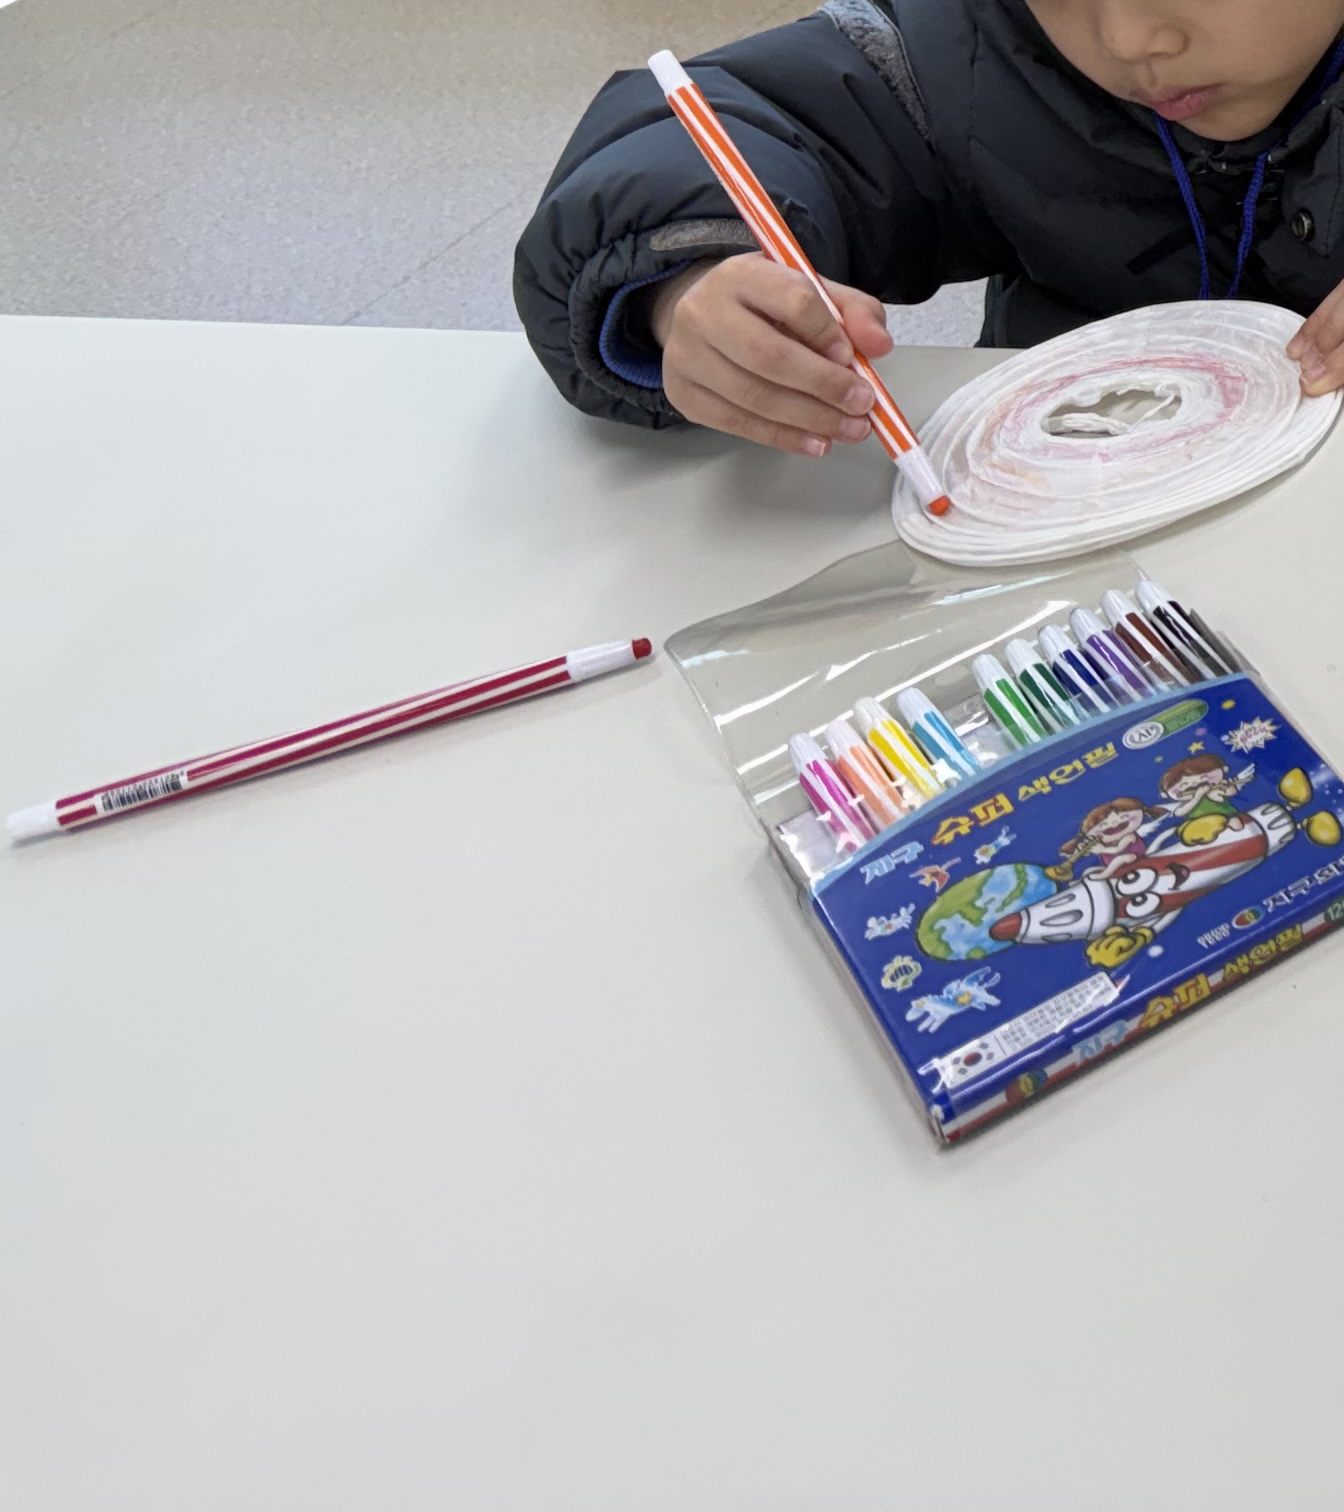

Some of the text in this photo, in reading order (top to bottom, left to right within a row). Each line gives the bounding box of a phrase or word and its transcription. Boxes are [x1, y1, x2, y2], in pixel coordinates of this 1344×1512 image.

[859, 743, 1119, 884] 지구 슈퍼 색연필
[1071, 1019, 1133, 1062] 지구
[1135, 974, 1213, 1029] 슈퍼
[1220, 924, 1306, 981] 색연필
